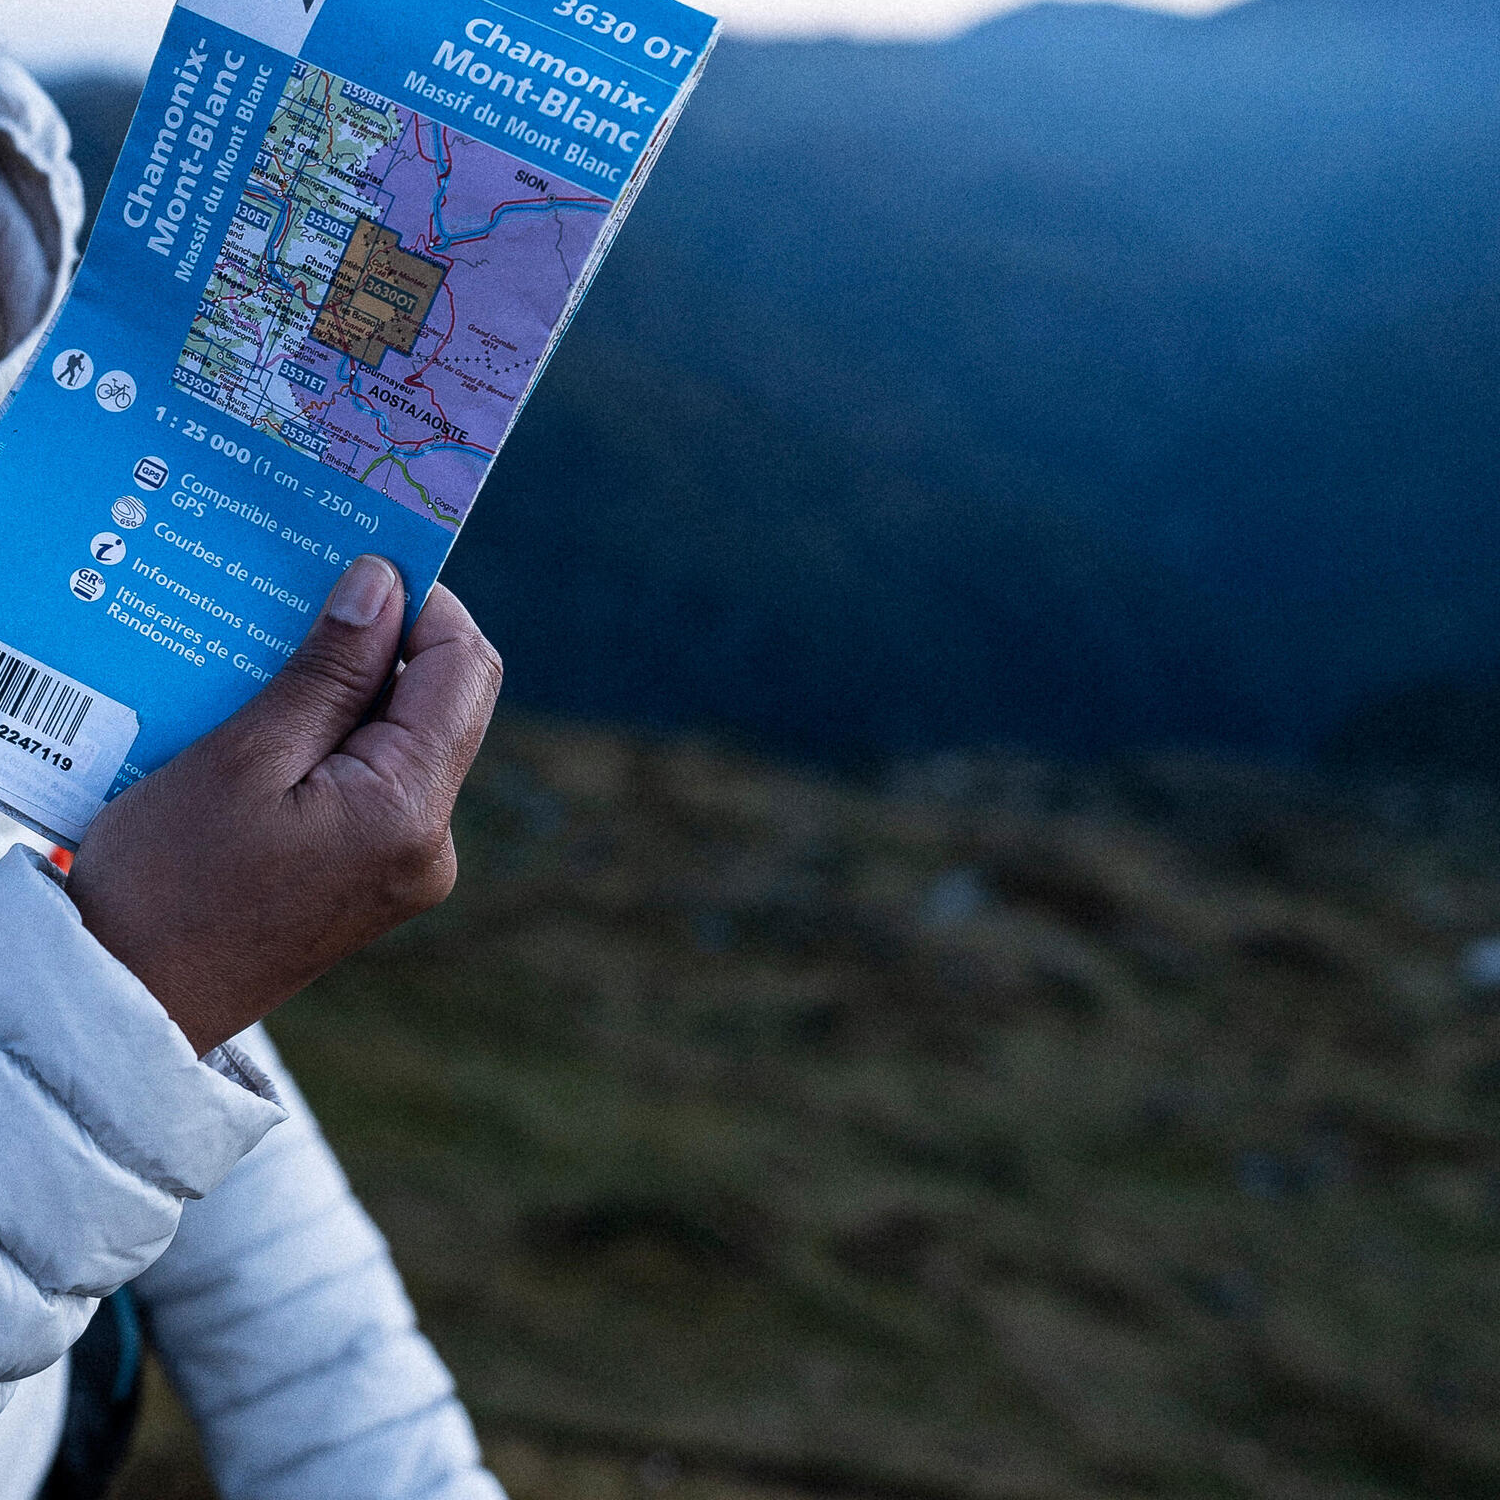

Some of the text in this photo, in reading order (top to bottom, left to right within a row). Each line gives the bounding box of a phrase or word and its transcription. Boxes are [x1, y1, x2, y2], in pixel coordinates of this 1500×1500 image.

[464, 18, 656, 115] Chamonix-
[643, 36, 693, 69] OT
[236, 63, 273, 123] Blanc
[342, 81, 390, 110] 3528ET
[431, 40, 640, 153] Mont-Blanc
[123, 38, 209, 228] Chamonix-
[335, 113, 348, 124] Pas
[349, 119, 360, 129] de
[342, 106, 388, 133] Abondance
[403, 70, 622, 183] Massif du Mont Blanc
[147, 50, 245, 257] Mont-Blanc
[212, 125, 248, 183] Mont
[281, 135, 320, 160] les Gets
[346, 163, 384, 185] Avoriaz
[514, 169, 549, 193] SION
[202, 181, 224, 214] du
[306, 210, 352, 241] 3530ET
[315, 233, 339, 250] Flaine
[174, 213, 212, 283] Massif
[219, 246, 249, 266] Clusaz
[365, 278, 418, 311] 3630OT
[467, 323, 518, 353] Grand Combin
[481, 340, 499, 351] 4314
[172, 368, 219, 398] 3532OT
[280, 362, 326, 392] 3531ET
[358, 363, 416, 396] Courmayeur
[443, 363, 454, 373] du
[454, 369, 477, 385] Grand
[477, 378, 517, 403] St-Bernard
[225, 393, 251, 411] Bourg-
[368, 385, 469, 444] AOSTA/AOSTE
[281, 422, 327, 452] 3532ET
[142, 466, 161, 482] GPS
[155, 406, 167, 422] 1
[182, 420, 208, 442] 25
[209, 434, 251, 464] 000
[253, 455, 271, 476] (1
[273, 470, 300, 491] cm
[318, 490, 353, 517] 250
[354, 511, 381, 534] m)
[170, 490, 208, 519] GPS
[181, 473, 278, 533] Compatible
[280, 526, 323, 556] avec
[323, 543, 341, 565] le
[434, 496, 459, 515] Cogne
[119, 517, 137, 528] 650
[153, 521, 311, 614] Courbes de niveau
[131, 557, 244, 629] Informations
[106, 602, 207, 668] Randonnée
[115, 585, 204, 644] Itinéraires
[205, 638, 229, 659] de
